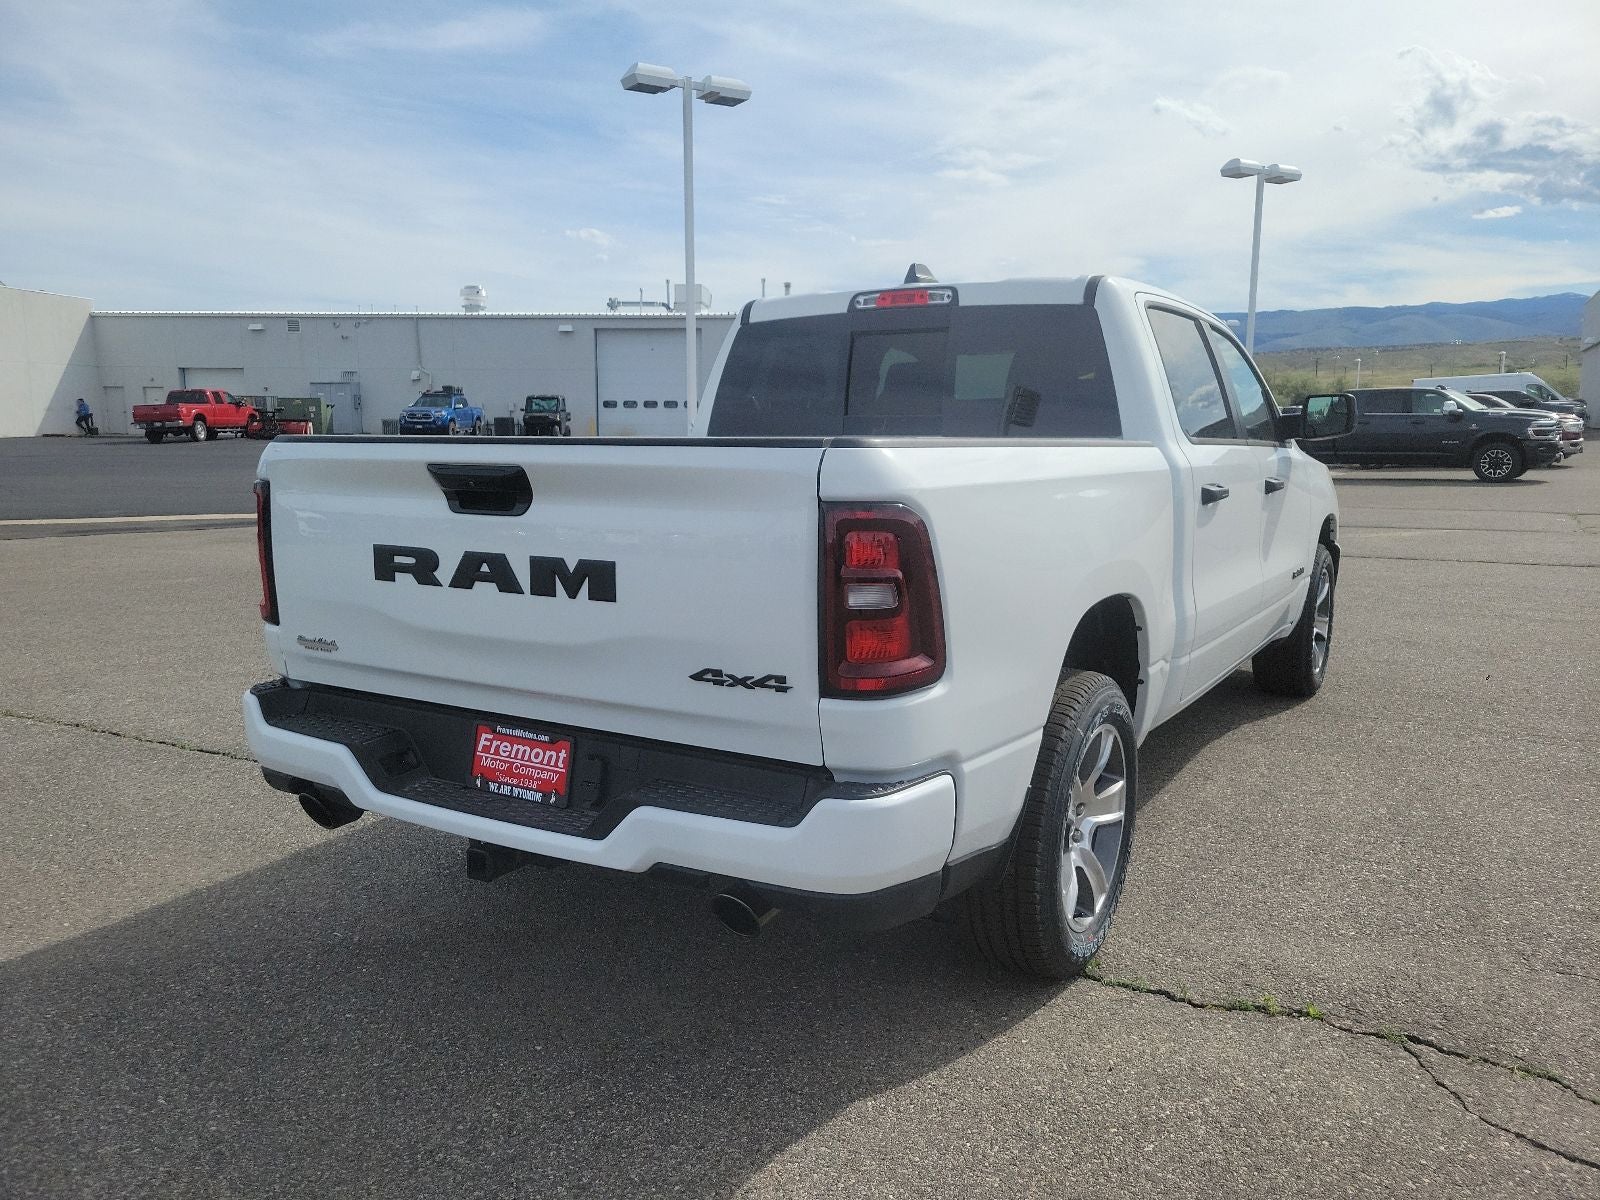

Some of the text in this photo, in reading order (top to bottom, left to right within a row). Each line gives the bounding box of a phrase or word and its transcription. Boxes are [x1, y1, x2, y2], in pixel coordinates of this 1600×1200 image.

[373, 543, 616, 602] RAM
[688, 667, 793, 693] 4x4
[478, 733, 567, 768] Fremont
[480, 756, 560, 783] Motor Company
[489, 782, 543, 802] WE ARE WYOMING
